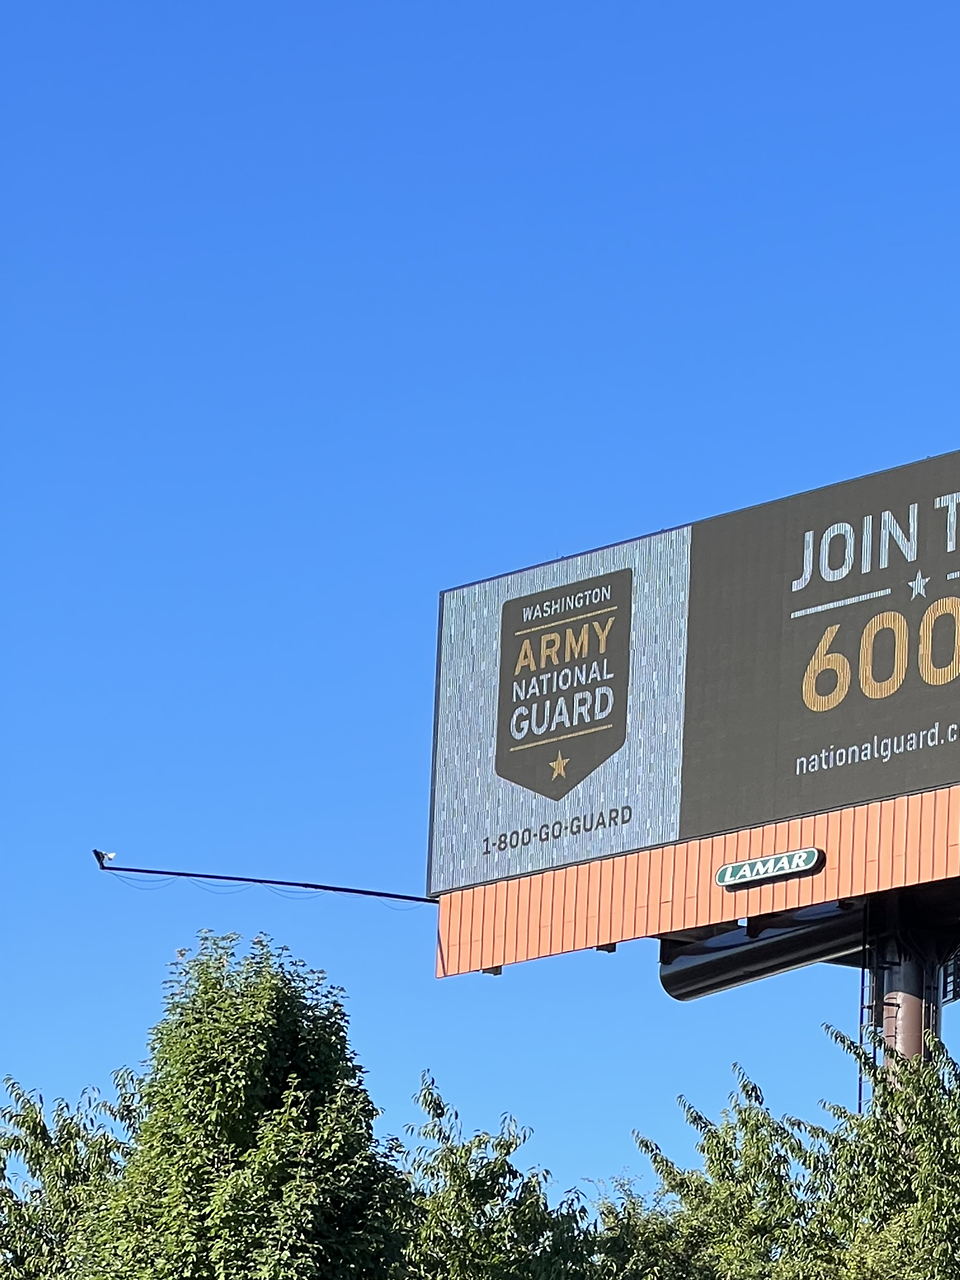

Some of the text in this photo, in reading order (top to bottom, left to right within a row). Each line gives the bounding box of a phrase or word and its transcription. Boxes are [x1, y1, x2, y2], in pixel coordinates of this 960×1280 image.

[791, 503, 918, 592] JOIN
[522, 585, 612, 622] WASHINGTON
[513, 617, 616, 676] ARMY
[512, 658, 615, 703] NATIONAL
[509, 686, 615, 741] GUARD
[482, 805, 633, 856] 1-800-GO-GUARD
[723, 852, 807, 882] LAMAR
